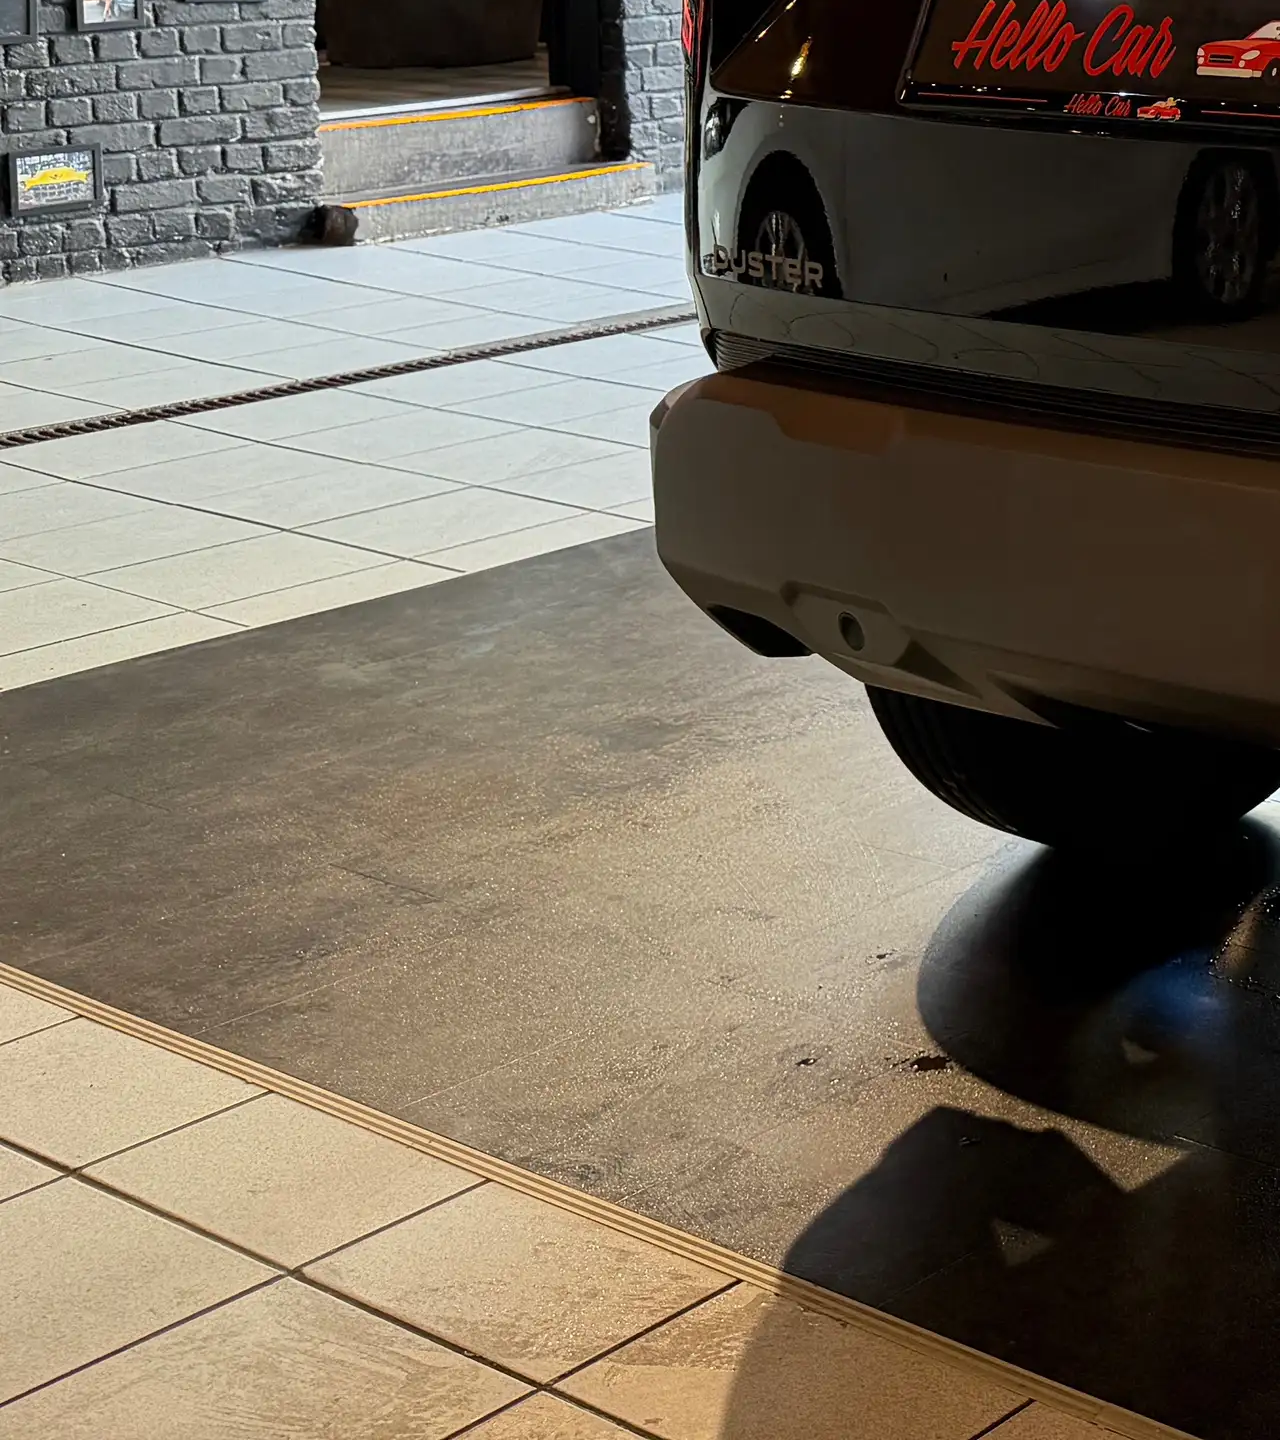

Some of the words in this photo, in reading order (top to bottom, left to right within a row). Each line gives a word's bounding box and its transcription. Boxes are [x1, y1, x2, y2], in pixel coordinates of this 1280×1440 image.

[1083, 4, 1177, 79] Car
[1063, 93, 1105, 117] Hello
[1105, 96, 1132, 118] Car
[713, 243, 823, 289] DUSTER
